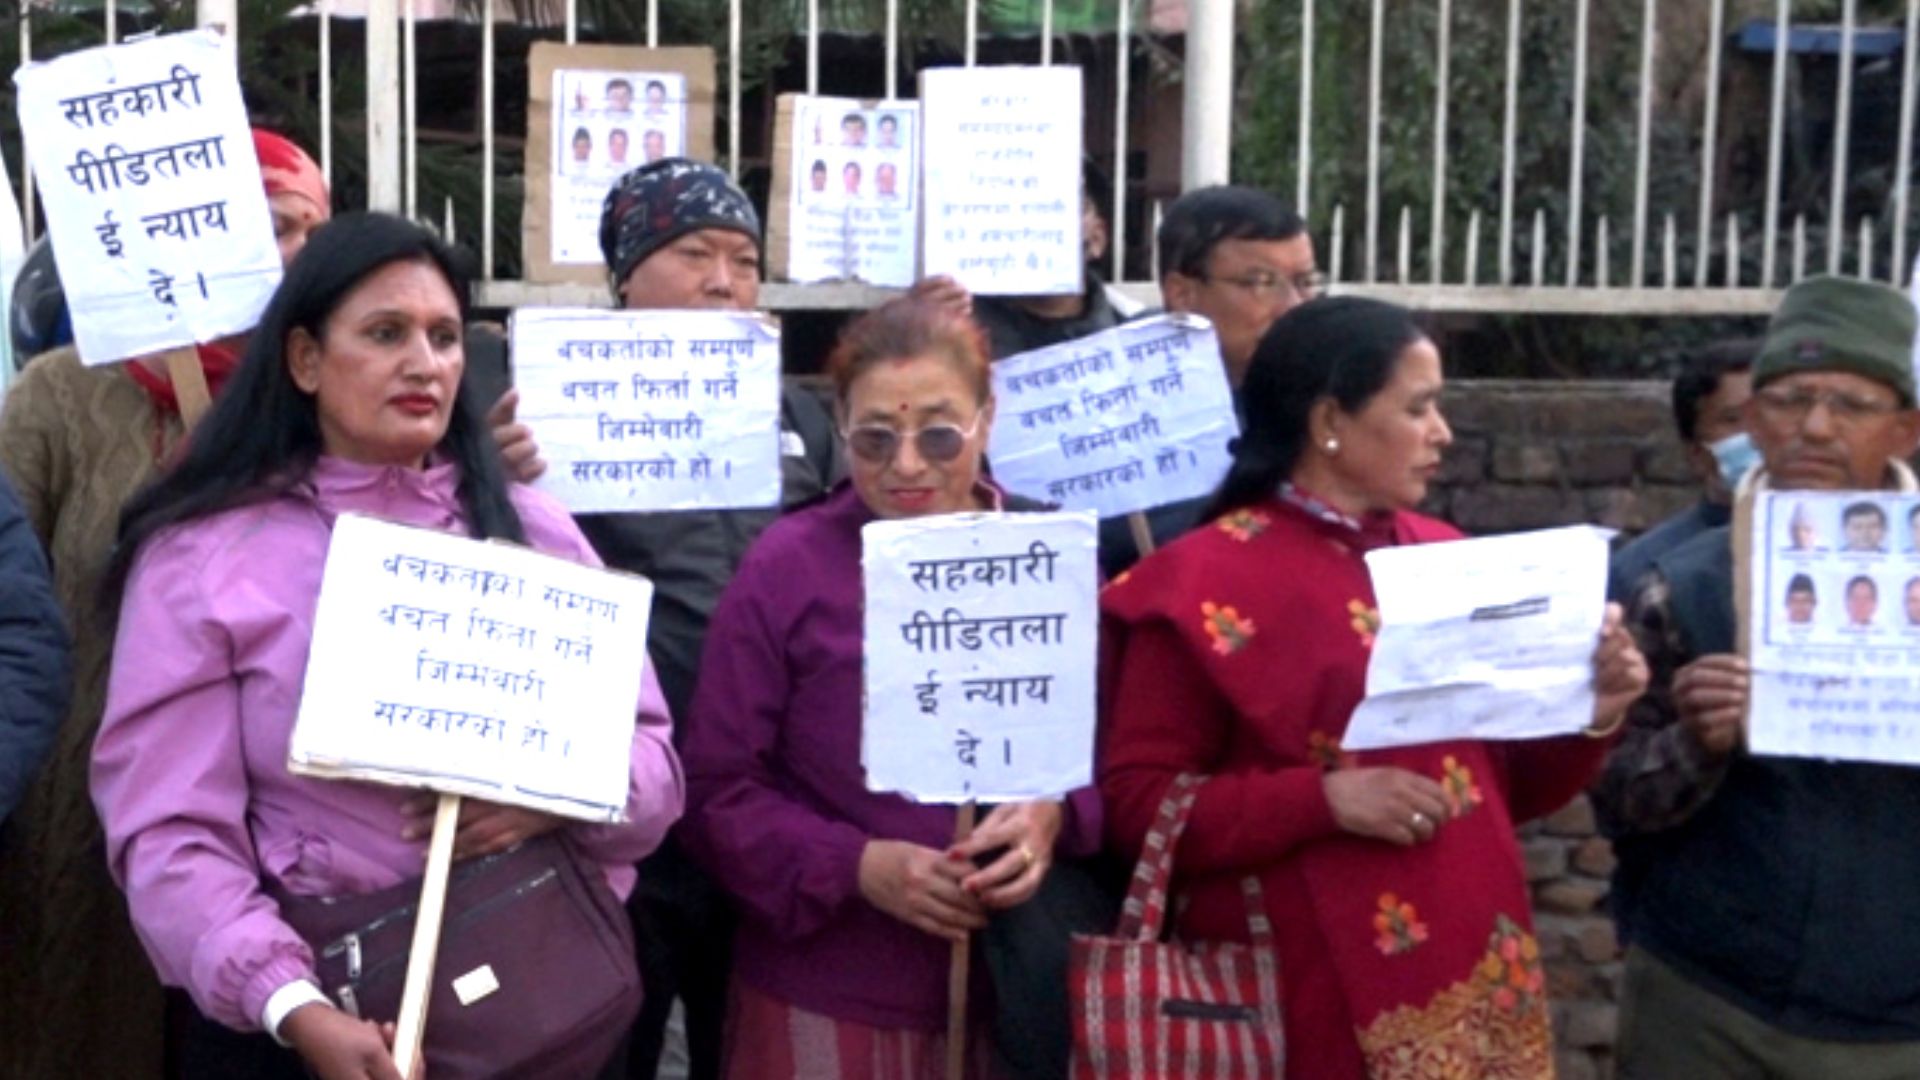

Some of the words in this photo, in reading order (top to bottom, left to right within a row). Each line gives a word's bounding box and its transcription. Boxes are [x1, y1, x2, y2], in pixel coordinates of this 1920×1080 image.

[58, 63, 203, 129] सहकारी
[65, 133, 227, 195] पीडितला
[94, 208, 126, 259] ई
[140, 199, 230, 241] न्याय
[147, 267, 178, 308] दे
[570, 452, 677, 482] सरकारको
[907, 539, 1061, 593] सहकारी
[899, 606, 1069, 652] पीडितला
[913, 668, 943, 716] ई
[961, 673, 1056, 707] न्याय
[954, 728, 982, 768] दे
